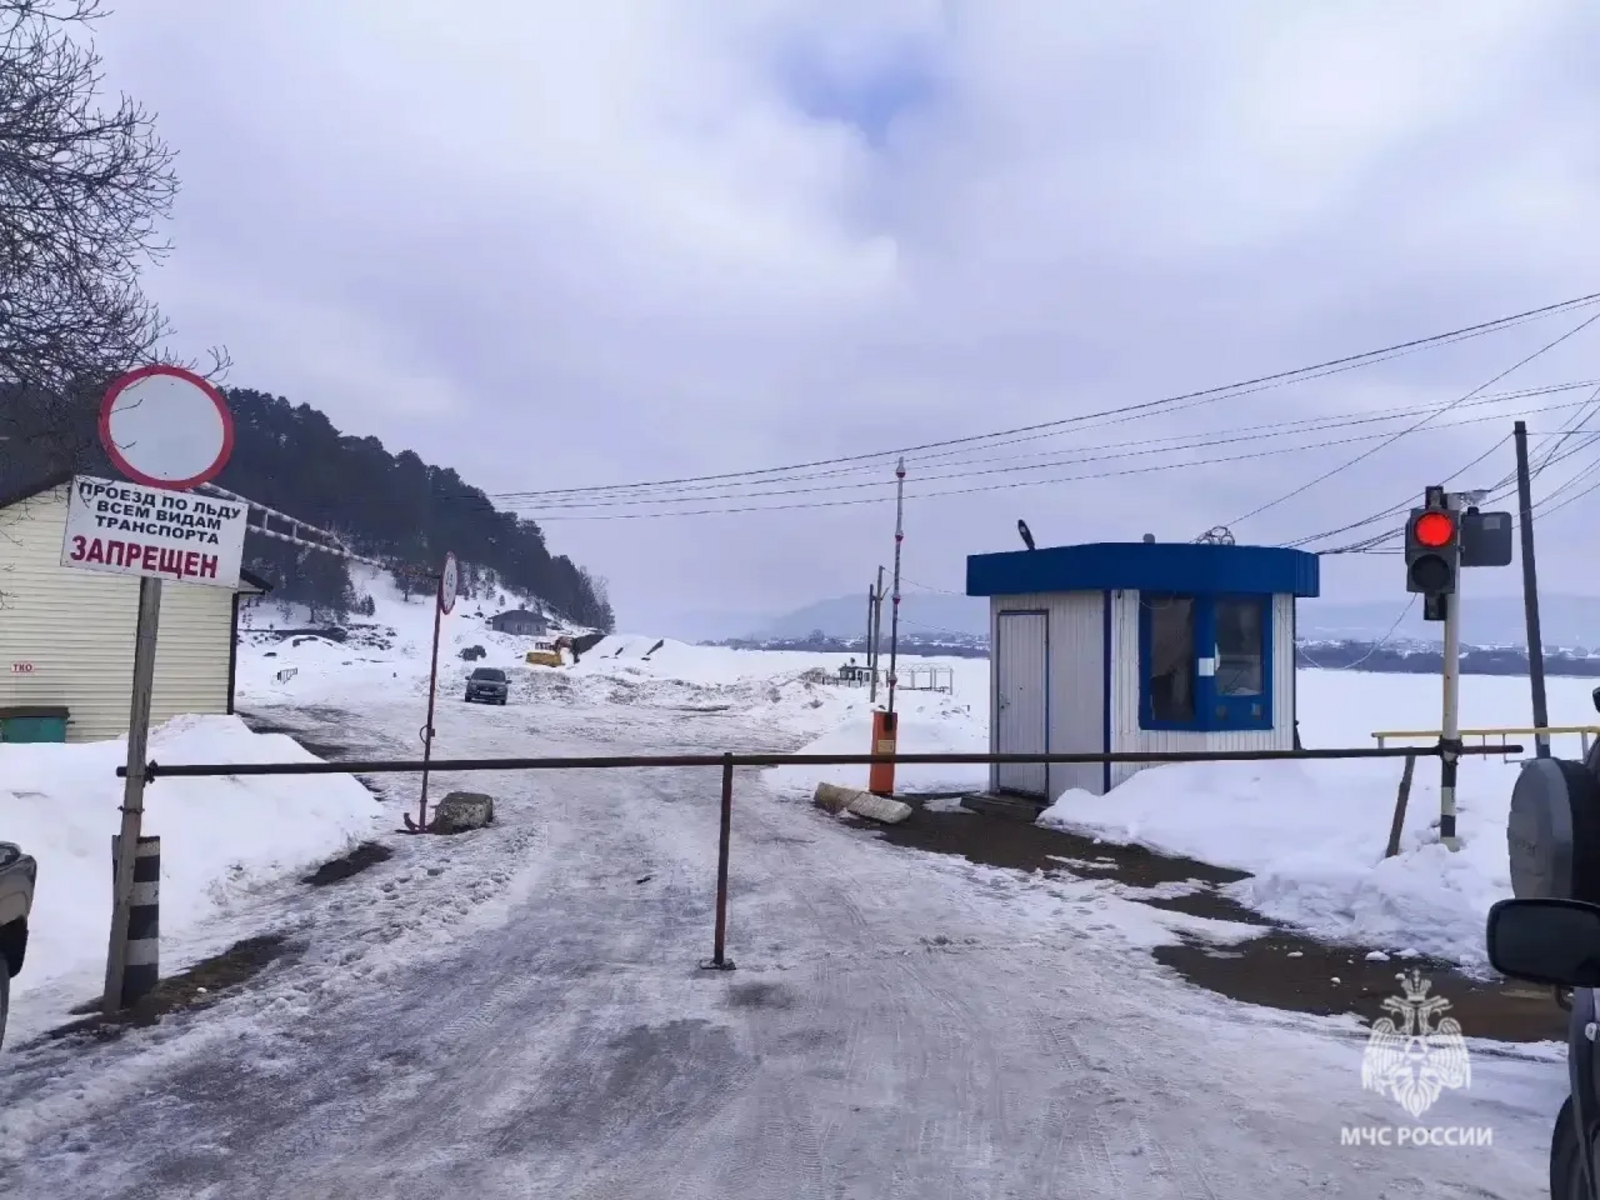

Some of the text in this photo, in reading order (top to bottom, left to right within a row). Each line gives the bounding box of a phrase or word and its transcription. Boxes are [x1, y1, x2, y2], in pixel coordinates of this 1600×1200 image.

[79, 482, 241, 520] ПРОЕЗД ПО ЛЬДУ
[96, 500, 221, 531] ВСЕМ ВИДАМ
[95, 514, 219, 545] ТРАНСПОРТА
[70, 535, 219, 579] ЗАПРЕЩЕН
